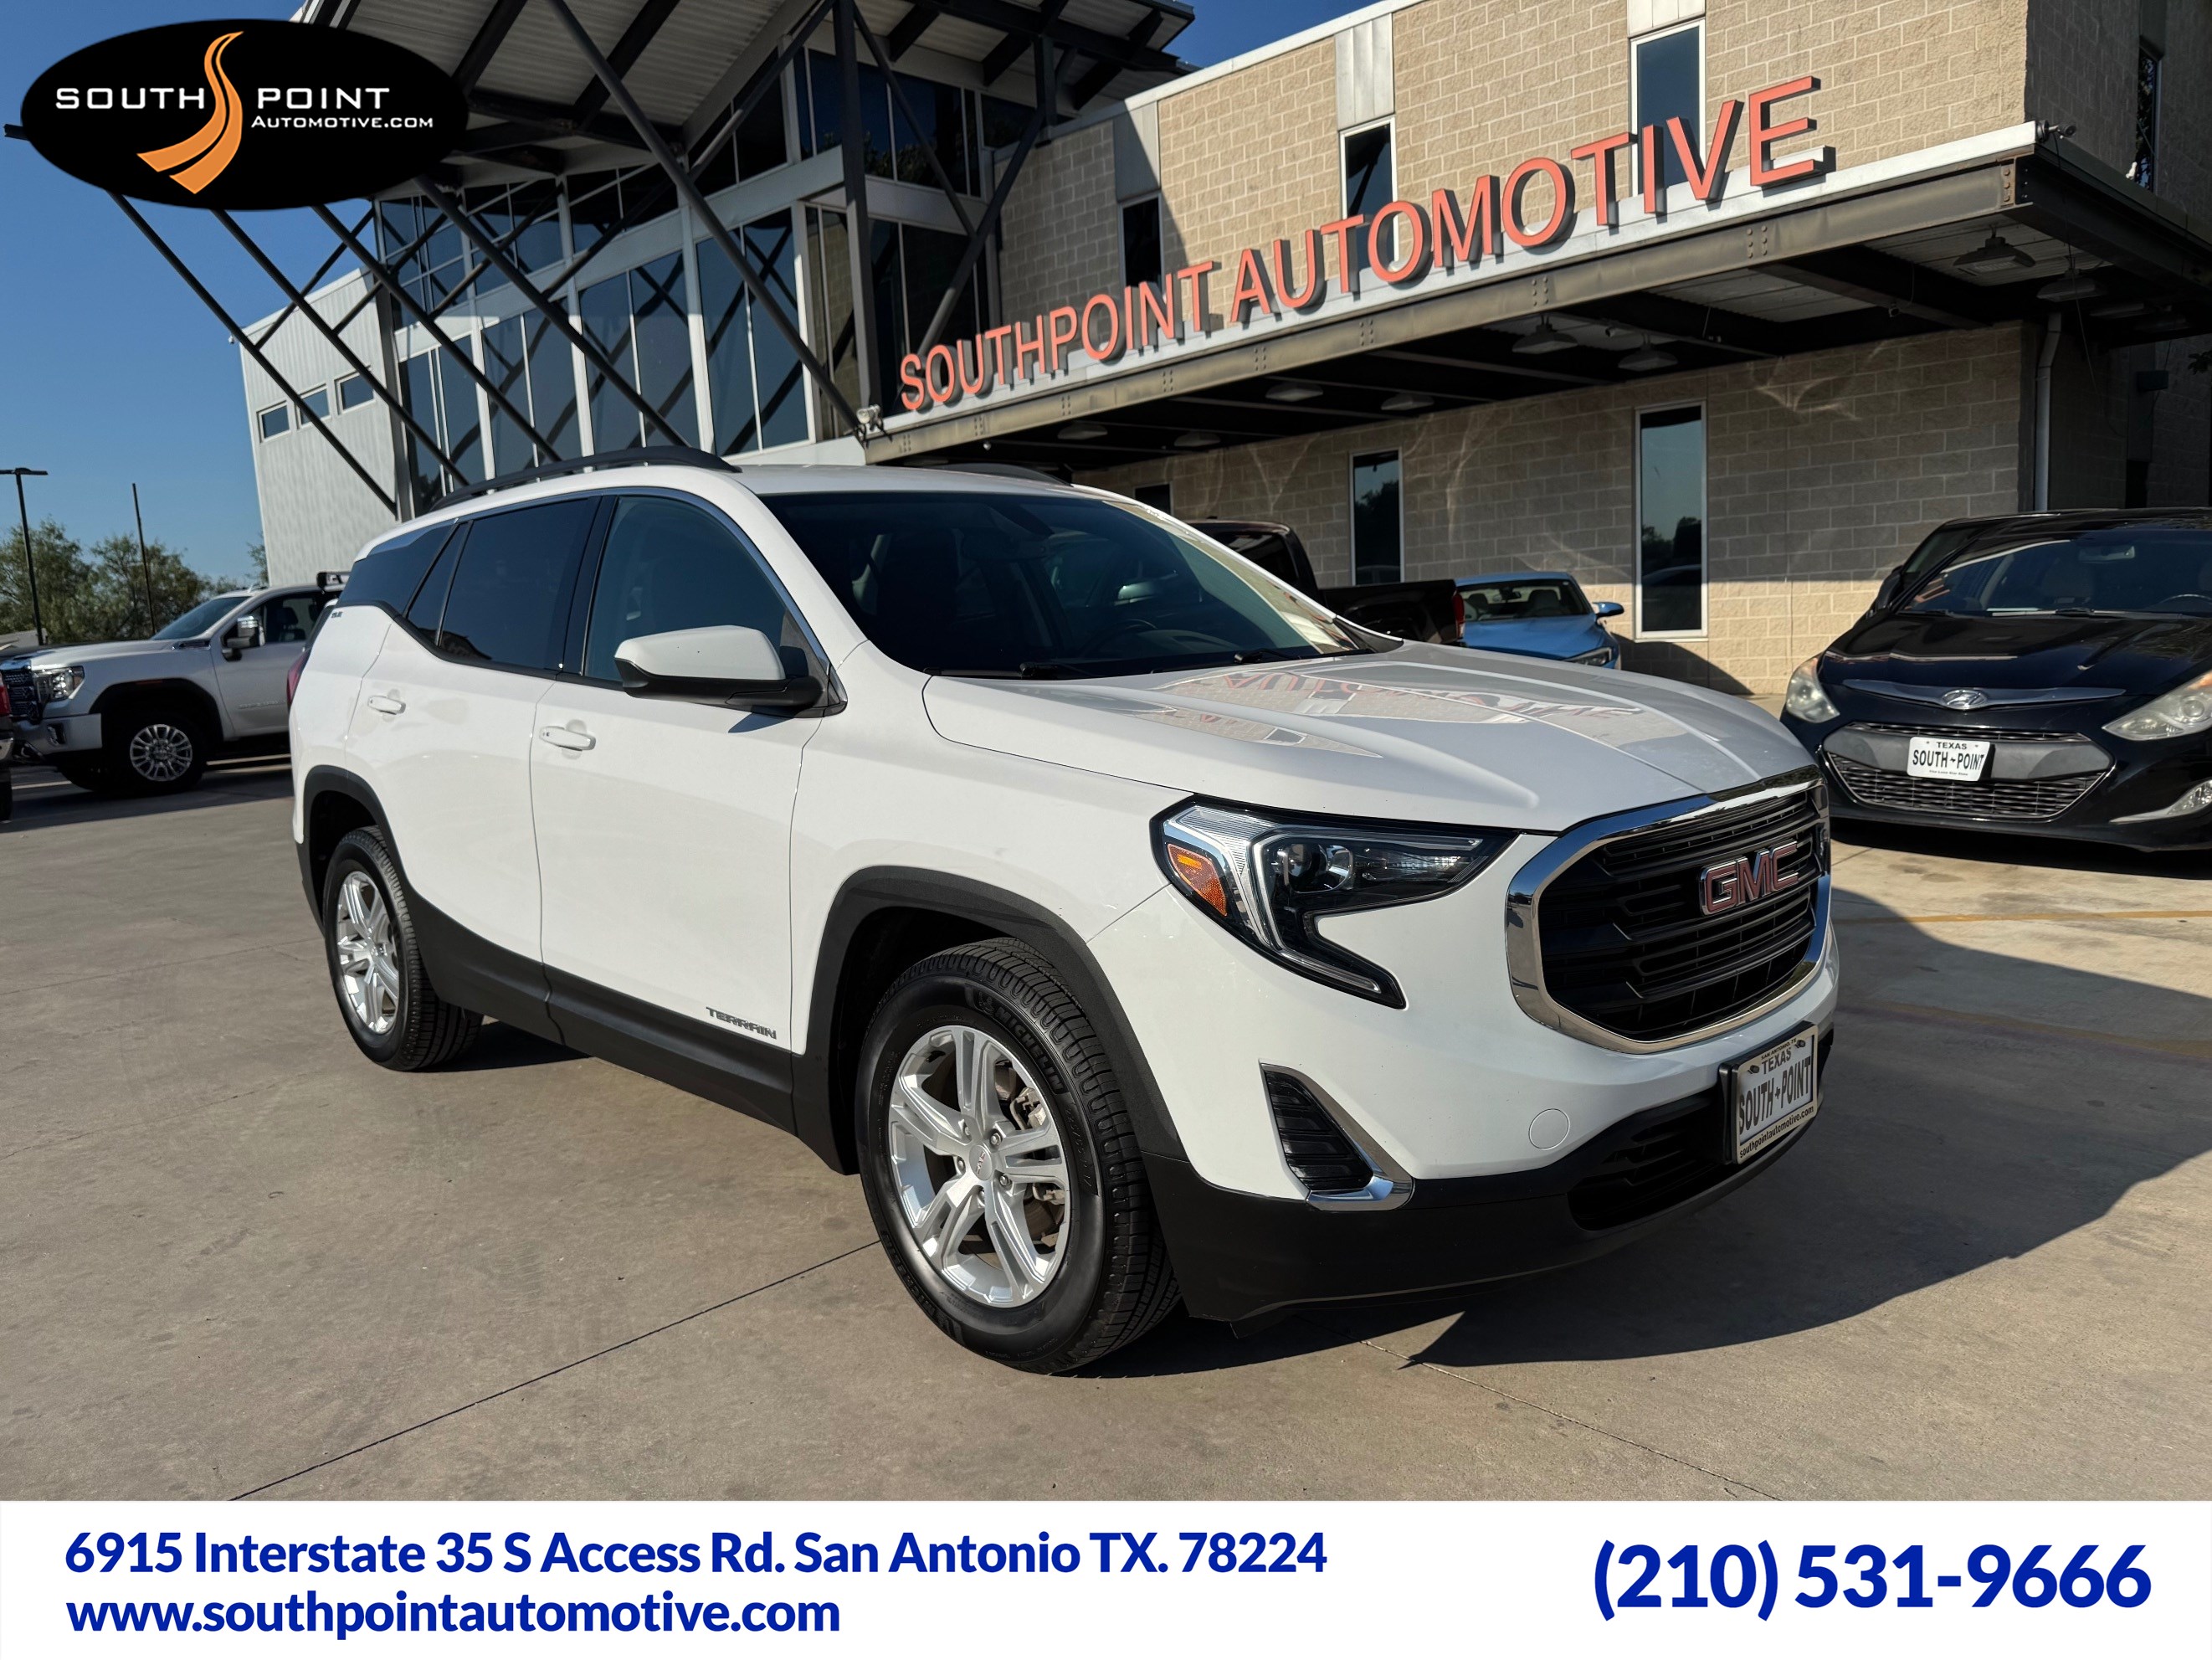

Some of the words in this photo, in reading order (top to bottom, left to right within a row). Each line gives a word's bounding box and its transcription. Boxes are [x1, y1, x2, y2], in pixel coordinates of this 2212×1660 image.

[900, 260, 1217, 411] SOUTHPOINT
[1229, 75, 1825, 325] AUTOMOTIVE
[1937, 741, 1968, 750] TEXAS
[1700, 840, 1799, 916] GMC
[706, 1006, 778, 1040] TERRAIN
[993, 1006, 1065, 1091] MICHELIN
[1762, 1048, 1792, 1075] TEXAS
[1739, 1106, 1814, 1159] southpointautomotive.com
